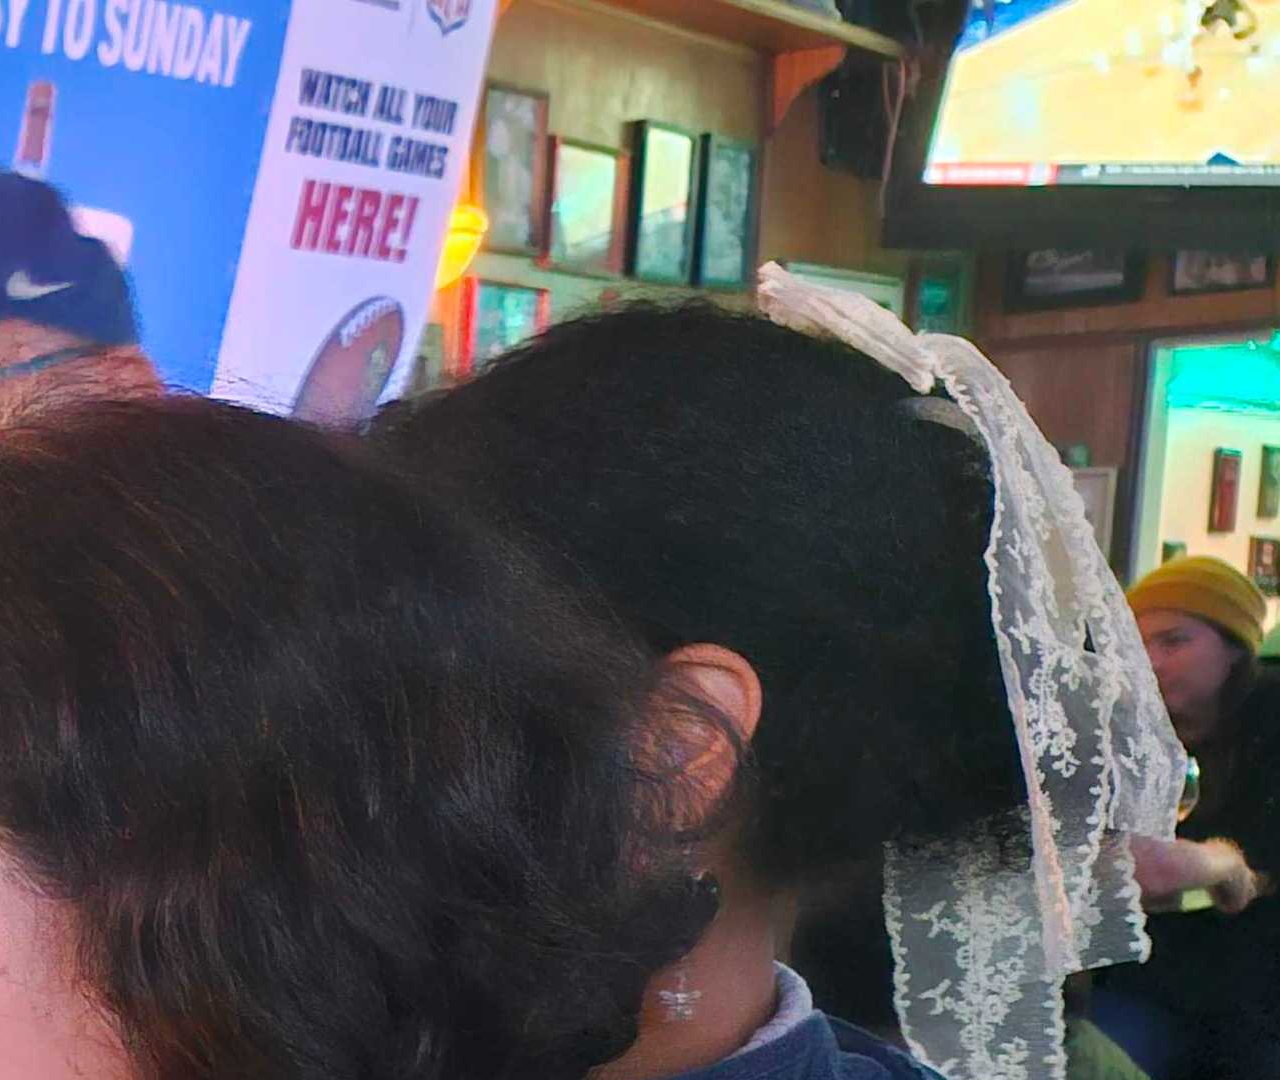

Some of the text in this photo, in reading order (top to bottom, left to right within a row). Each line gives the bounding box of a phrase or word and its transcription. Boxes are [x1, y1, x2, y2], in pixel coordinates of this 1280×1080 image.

[41, 0, 93, 60] TO
[97, 0, 252, 87] SUNDAY
[298, 68, 458, 135] WATCH ALL YOUR
[284, 115, 449, 180] FOOTBALL GAMES
[291, 178, 420, 264] HERE!
